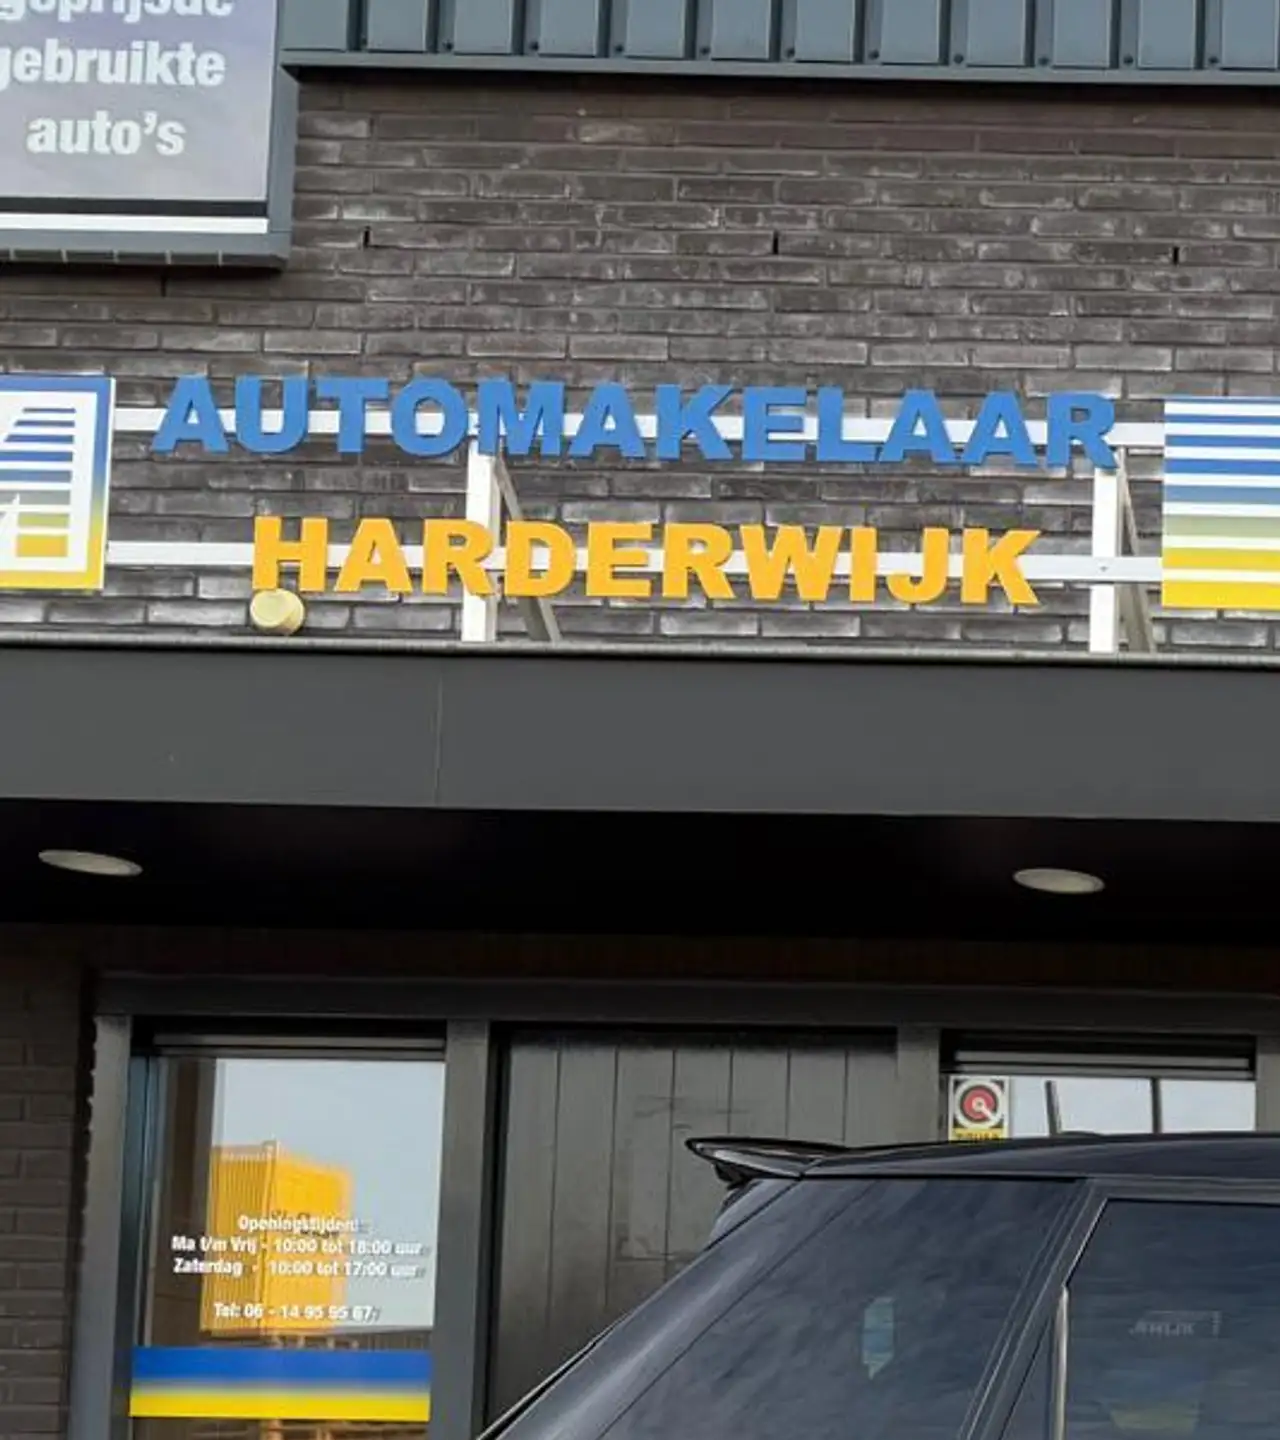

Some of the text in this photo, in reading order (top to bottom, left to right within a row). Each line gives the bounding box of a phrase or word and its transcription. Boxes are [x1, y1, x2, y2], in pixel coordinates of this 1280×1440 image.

[26, 110, 187, 156] auto's
[151, 373, 1117, 469] AUTOMAKELAAR
[252, 516, 1042, 606] HARDERWIJK
[171, 1236, 196, 1251] Ma
